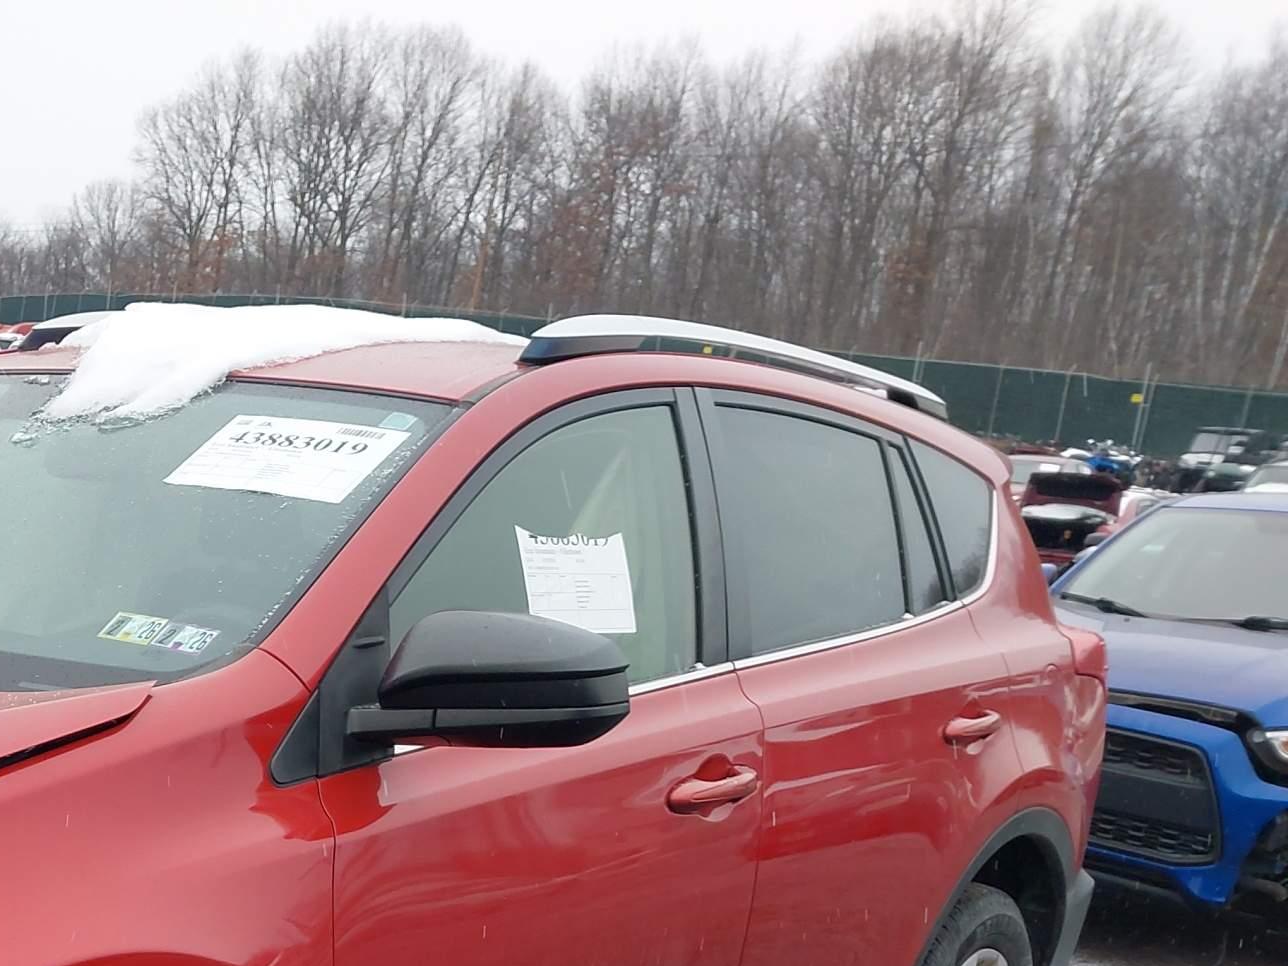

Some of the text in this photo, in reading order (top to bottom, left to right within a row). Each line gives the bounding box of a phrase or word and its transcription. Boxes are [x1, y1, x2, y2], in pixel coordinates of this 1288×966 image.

[229, 430, 370, 455] 43883019
[137, 621, 162, 640] 26
[158, 628, 213, 651] 2 26
